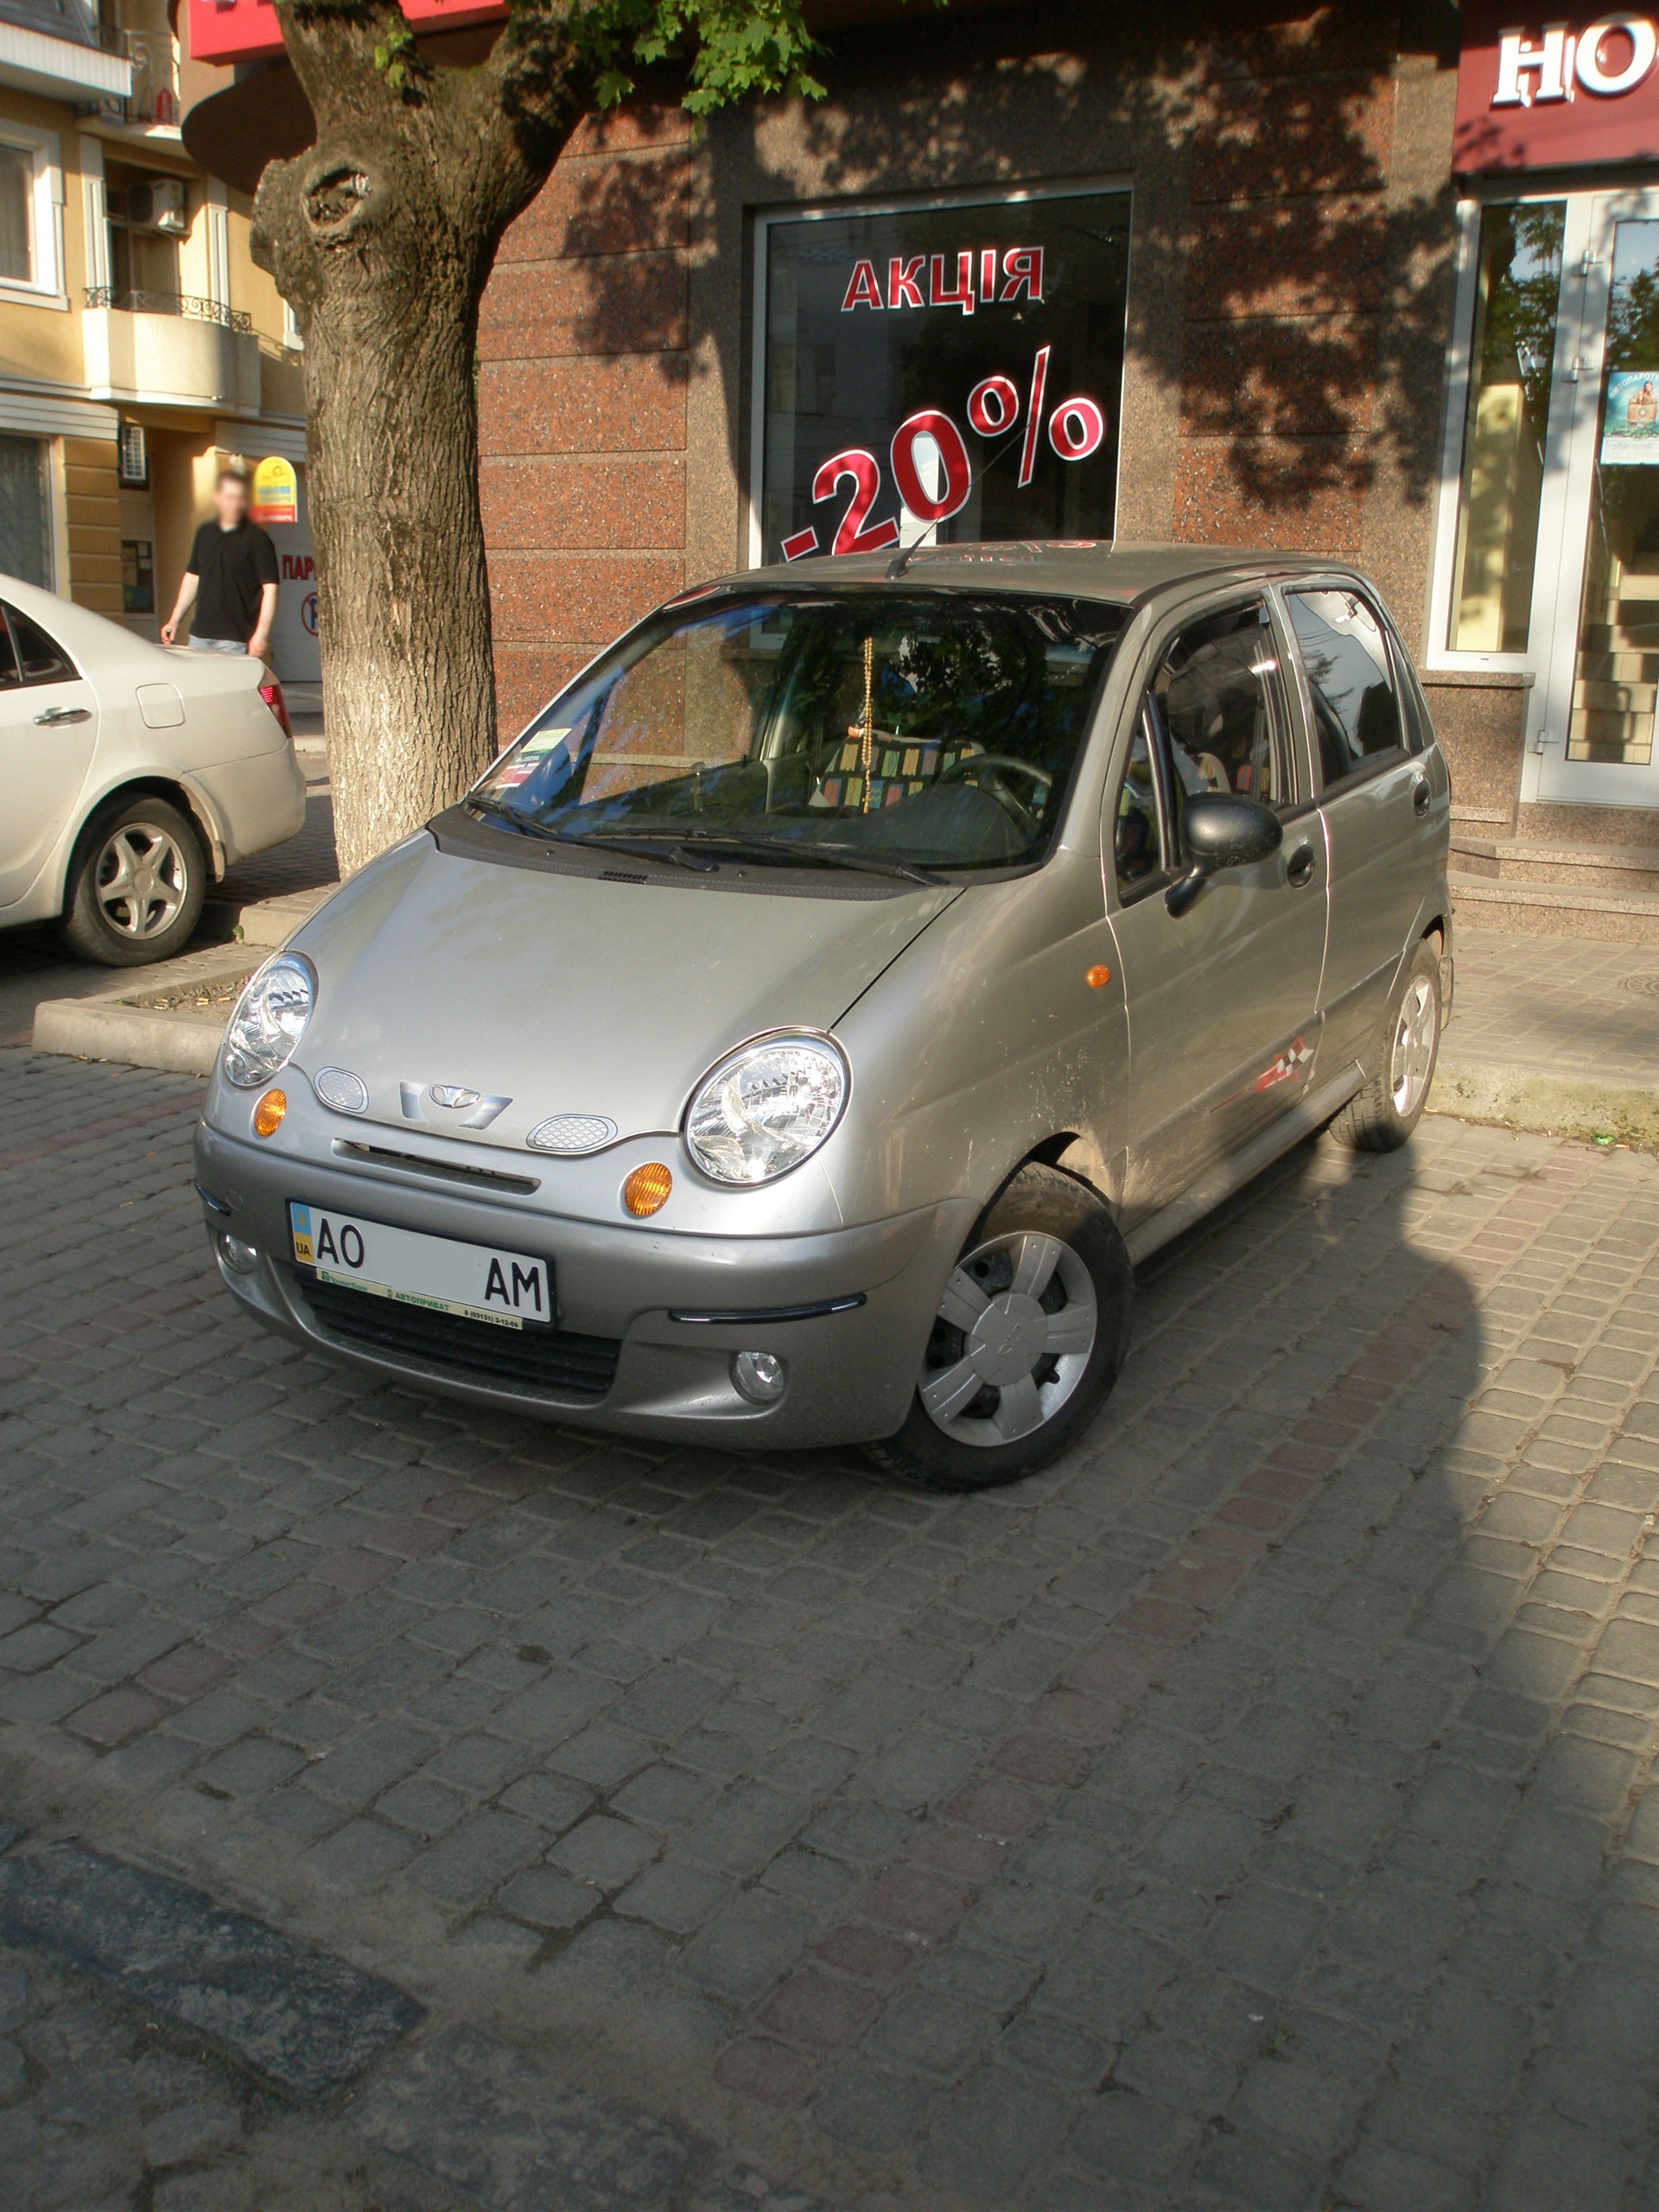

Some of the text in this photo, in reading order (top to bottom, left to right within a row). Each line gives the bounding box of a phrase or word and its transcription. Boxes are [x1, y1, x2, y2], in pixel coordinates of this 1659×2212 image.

[841, 246, 1044, 315] АКЦІЯ
[283, 555, 316, 581] ПАР
[296, 1241, 311, 1257] UA
[395, 1293, 449, 1311] АВТОПРИВАТ
